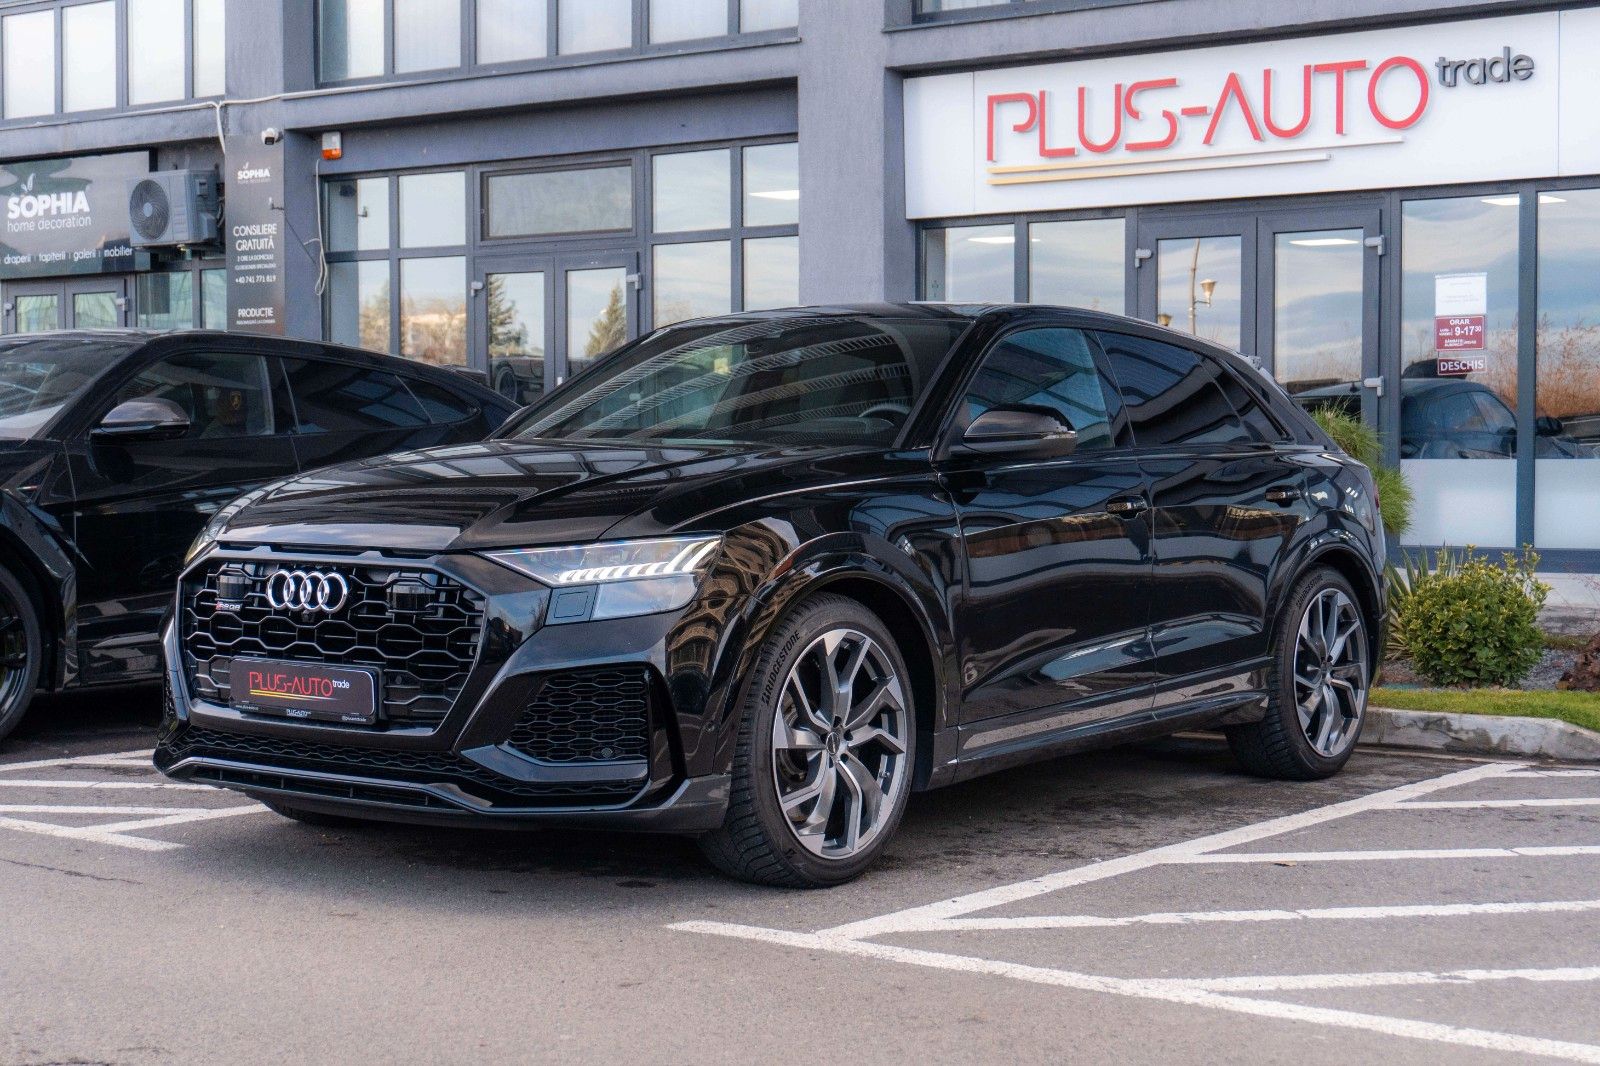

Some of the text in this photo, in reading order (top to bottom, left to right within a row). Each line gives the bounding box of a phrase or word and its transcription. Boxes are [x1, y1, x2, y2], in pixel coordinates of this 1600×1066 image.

[987, 46, 1534, 162] PLUS-AUTO trade
[237, 168, 271, 180] SOPHIA
[7, 190, 91, 220] SOPHIA
[7, 215, 92, 233] home decoration
[232, 223, 278, 237] CONSILIERE
[73, 248, 97, 262] galerii
[104, 245, 133, 258] mobilier
[1440, 359, 1484, 372] DESCHIS
[761, 629, 802, 707] BRIDGESTONE
[249, 671, 350, 697] PLUS-AUTO trade
